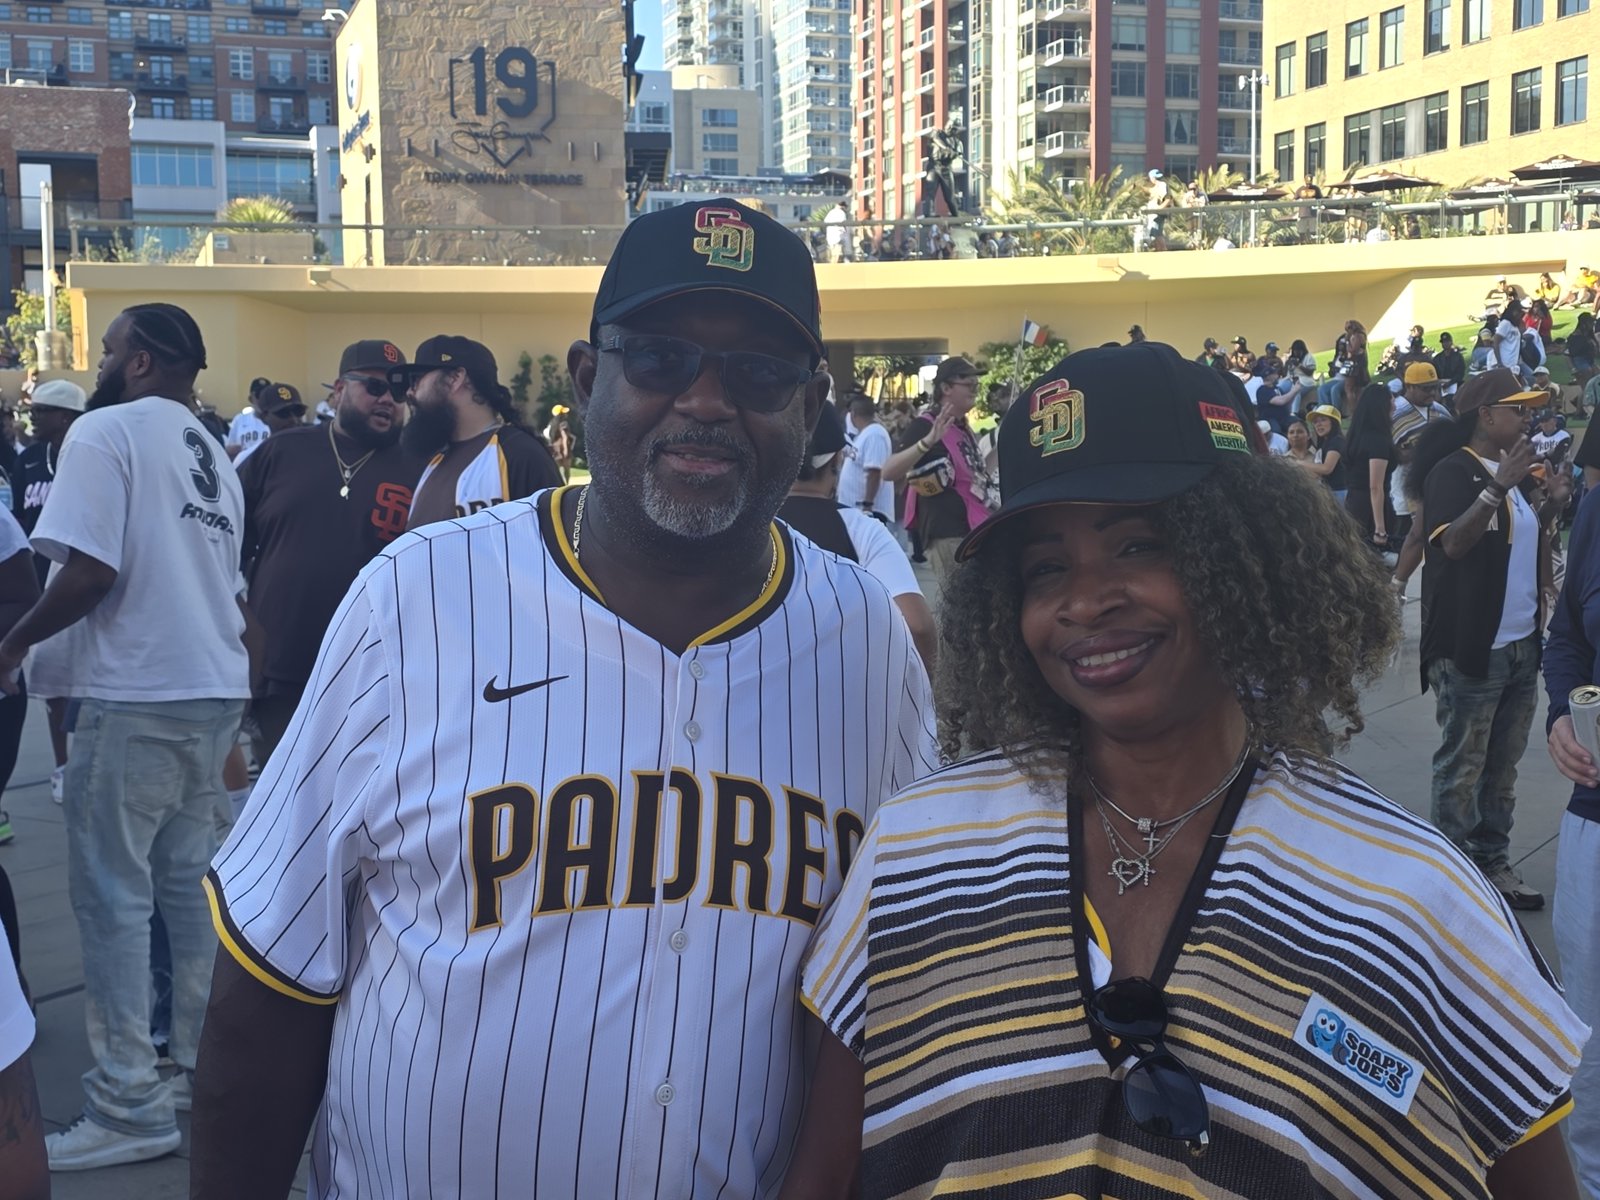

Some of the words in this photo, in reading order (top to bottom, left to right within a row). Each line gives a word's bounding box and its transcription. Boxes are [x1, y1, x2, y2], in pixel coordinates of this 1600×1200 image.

[469, 46, 539, 118] 19
[425, 171, 459, 184] TONY
[464, 172, 520, 185] GWYNN
[524, 174, 584, 186] TERRACE
[693, 206, 755, 272] SD
[1029, 378, 1086, 458] SD
[183, 427, 221, 503] 3
[1344, 1031, 1410, 1079] SOAPY
[1348, 1051, 1402, 1092] JOE'S
